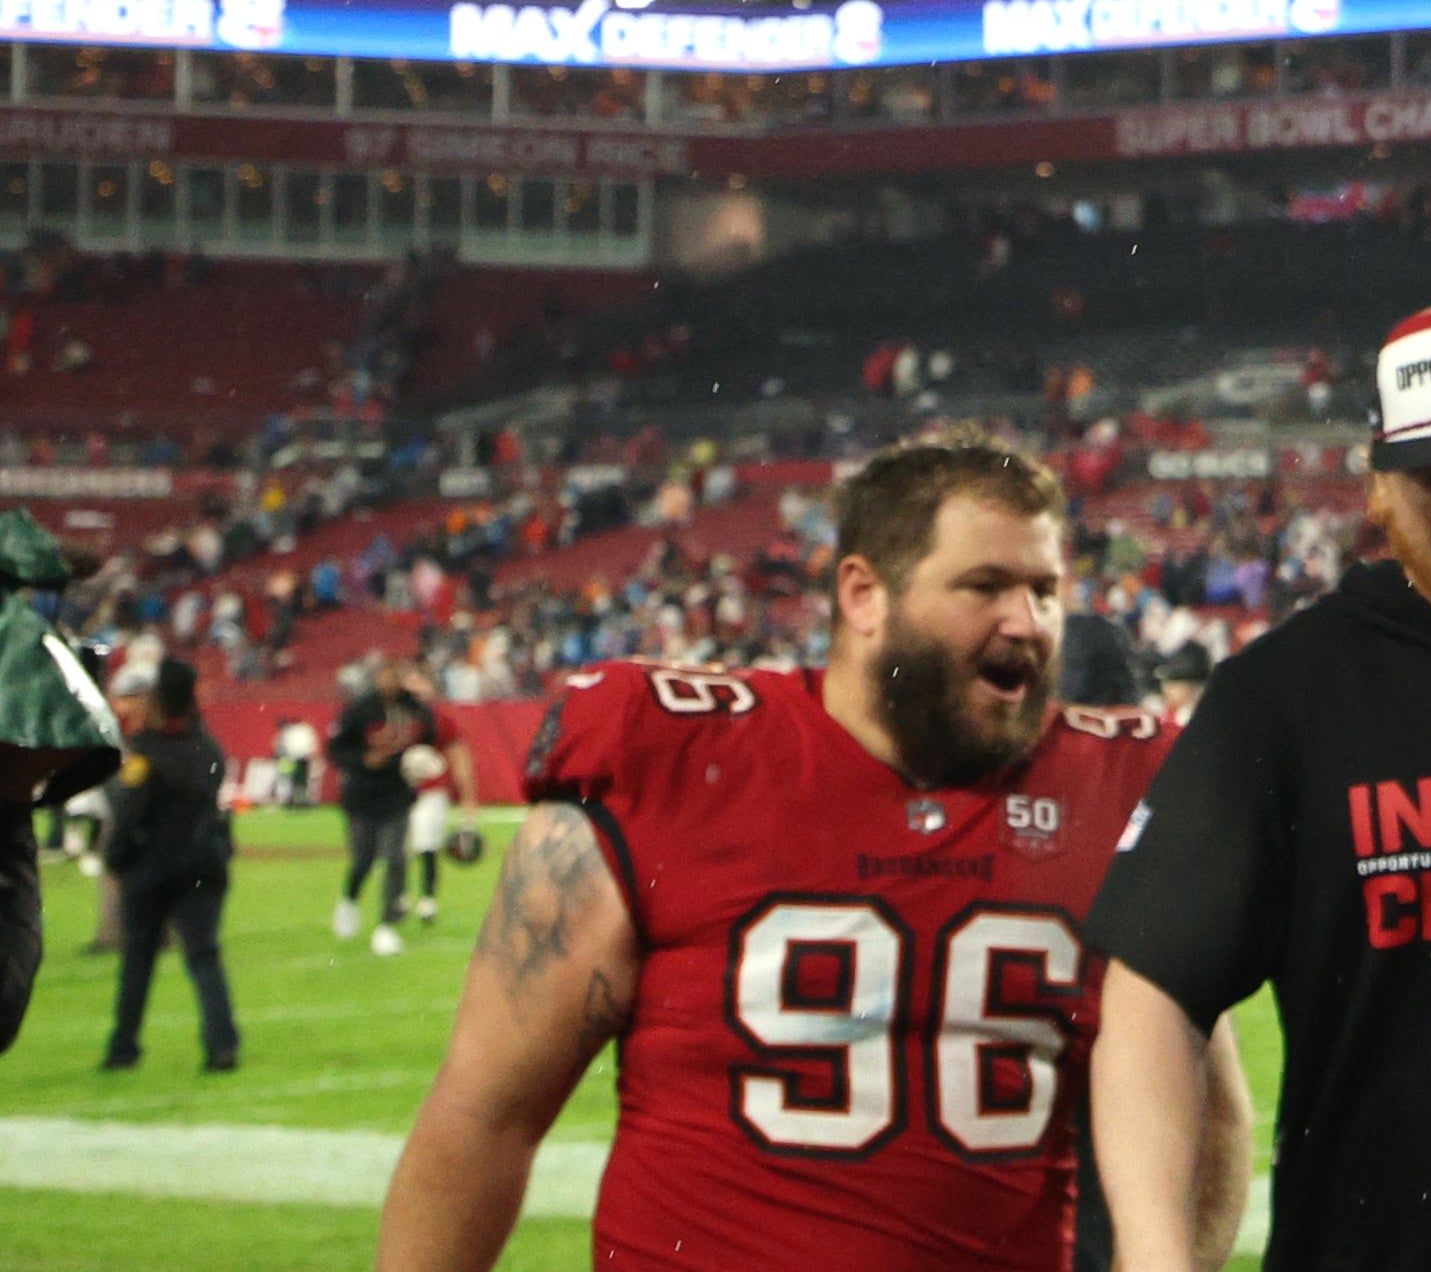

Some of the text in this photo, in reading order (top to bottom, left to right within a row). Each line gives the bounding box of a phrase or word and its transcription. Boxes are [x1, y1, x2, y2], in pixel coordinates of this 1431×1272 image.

[1117, 106, 1238, 157] SUPER
[1247, 99, 1358, 148] BOWL
[1006, 793, 1060, 833] 50
[730, 895, 1085, 1159] 96
